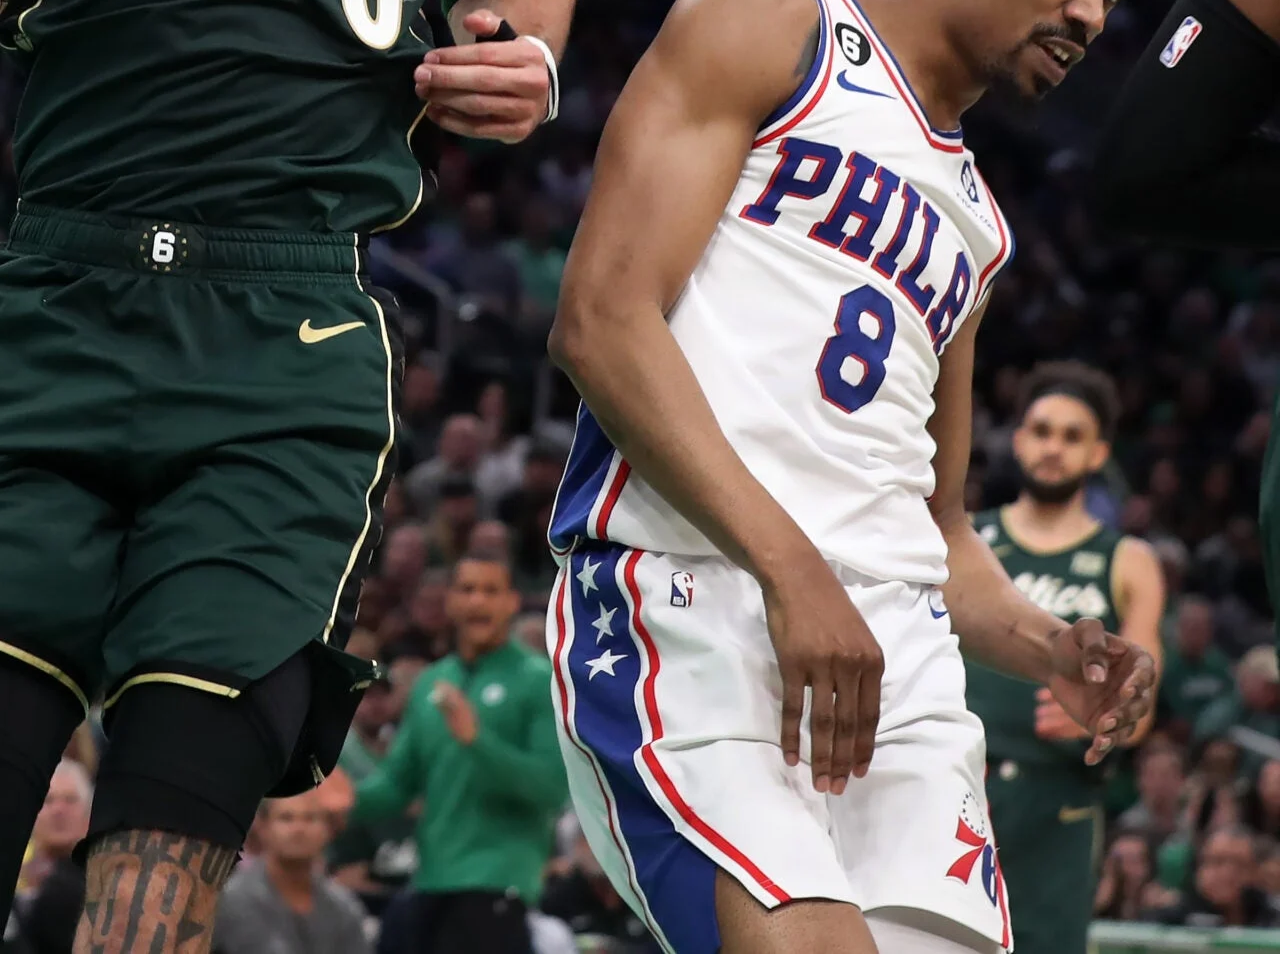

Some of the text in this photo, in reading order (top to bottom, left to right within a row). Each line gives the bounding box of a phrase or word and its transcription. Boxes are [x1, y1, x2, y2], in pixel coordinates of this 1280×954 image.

[840, 30, 861, 60] 6
[152, 231, 176, 263] 6
[738, 137, 971, 354] PHILA
[815, 284, 896, 414] 8
